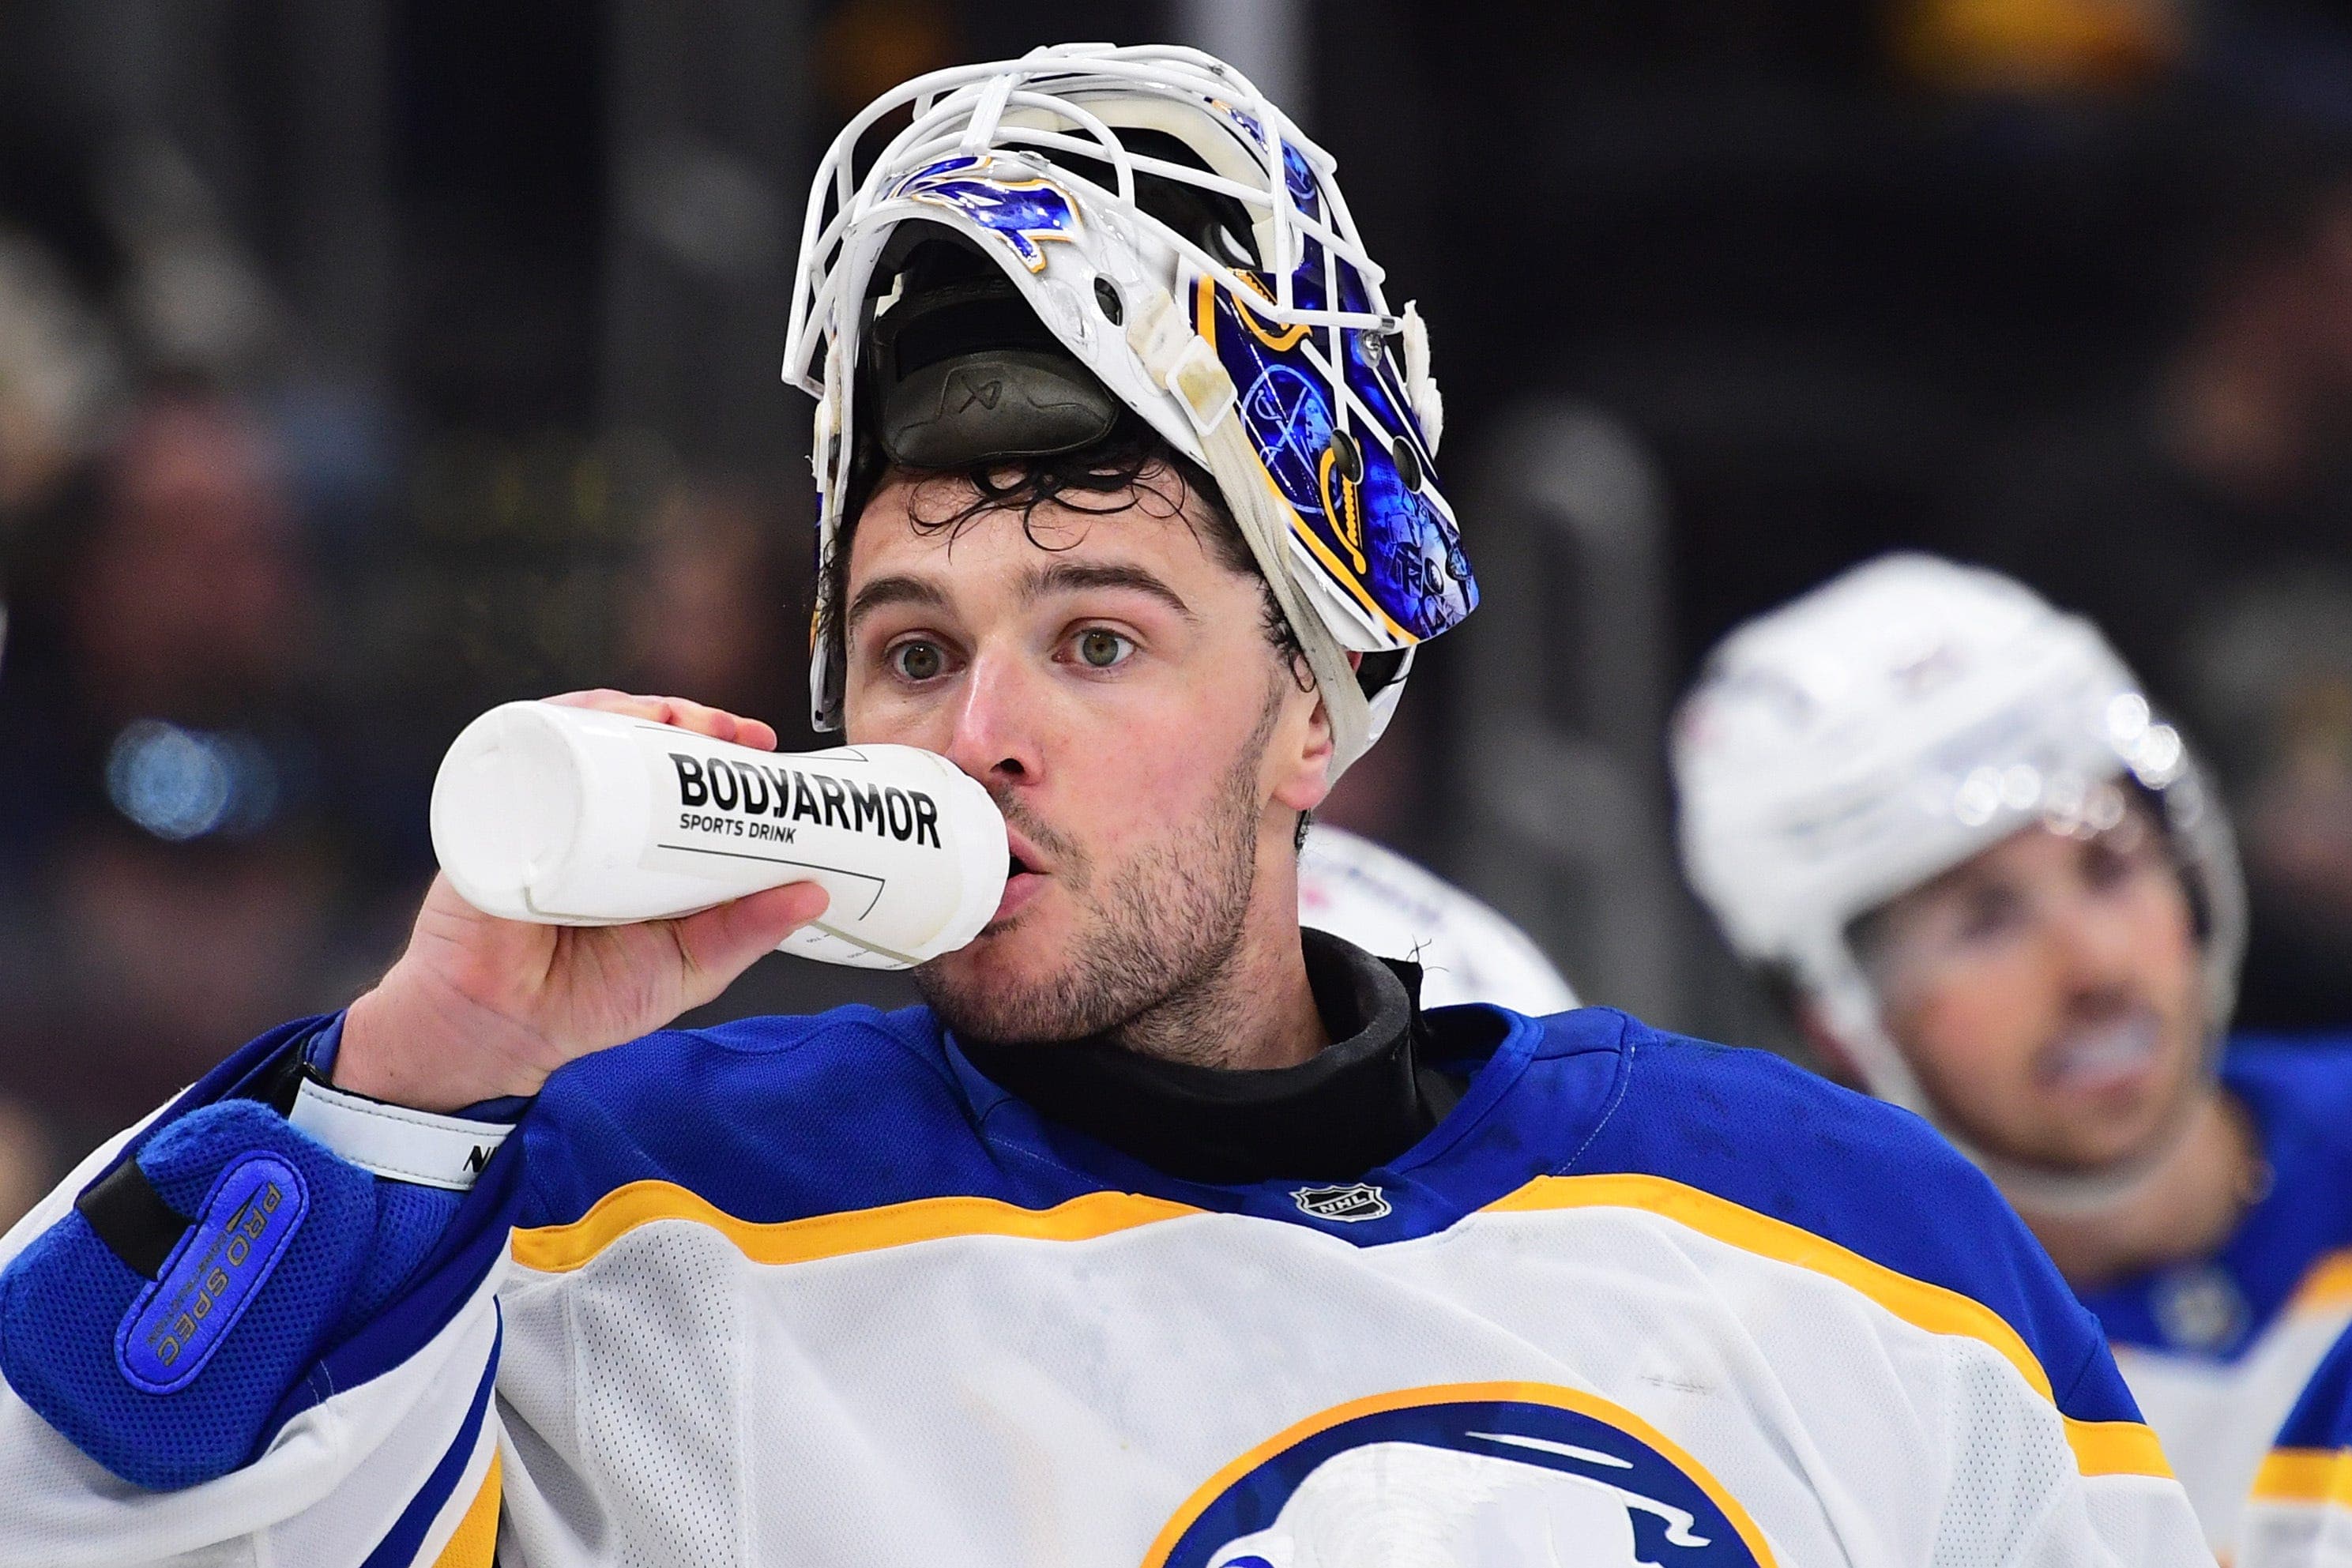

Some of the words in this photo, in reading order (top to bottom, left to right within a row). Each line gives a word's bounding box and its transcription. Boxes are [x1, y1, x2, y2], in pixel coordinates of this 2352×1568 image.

[668, 753, 942, 849] BODYARMOR
[679, 814, 744, 837] SPORTS
[748, 822, 797, 844] DRINK
[226, 1181, 283, 1266] PRO
[1319, 1194, 1367, 1214] NHL
[156, 1266, 229, 1367] SPEC
